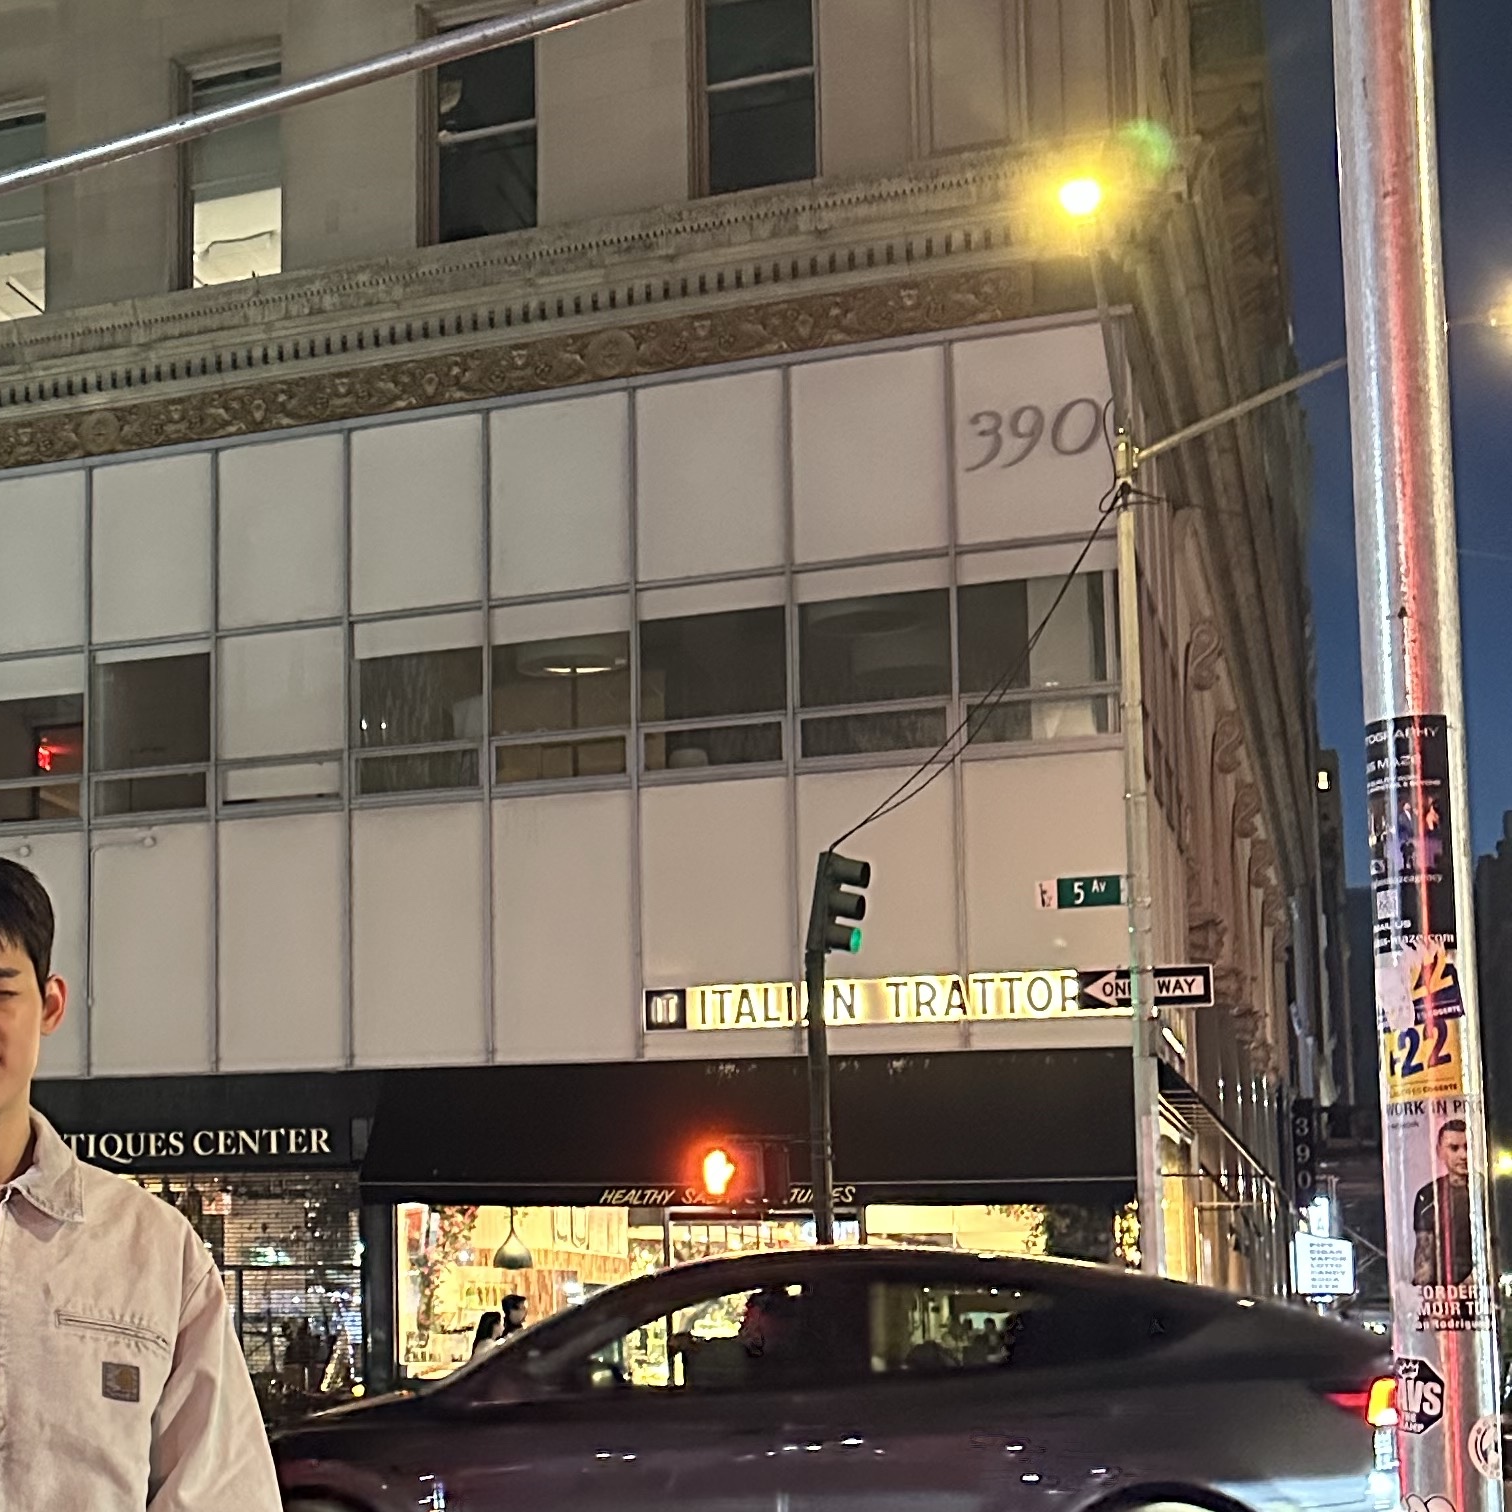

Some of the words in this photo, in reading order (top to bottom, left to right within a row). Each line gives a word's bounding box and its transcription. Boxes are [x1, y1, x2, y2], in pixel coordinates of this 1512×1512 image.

[964, 397, 1103, 473] 390
[1073, 881, 1085, 905] 5
[700, 983, 856, 1025] ITALIN
[886, 976, 1079, 1018] TRATTOR
[1157, 977, 1197, 995] WAY
[64, 1131, 185, 1165] TIQUES
[193, 1127, 332, 1157] CENTER
[599, 1187, 677, 1206] HEALTHY
